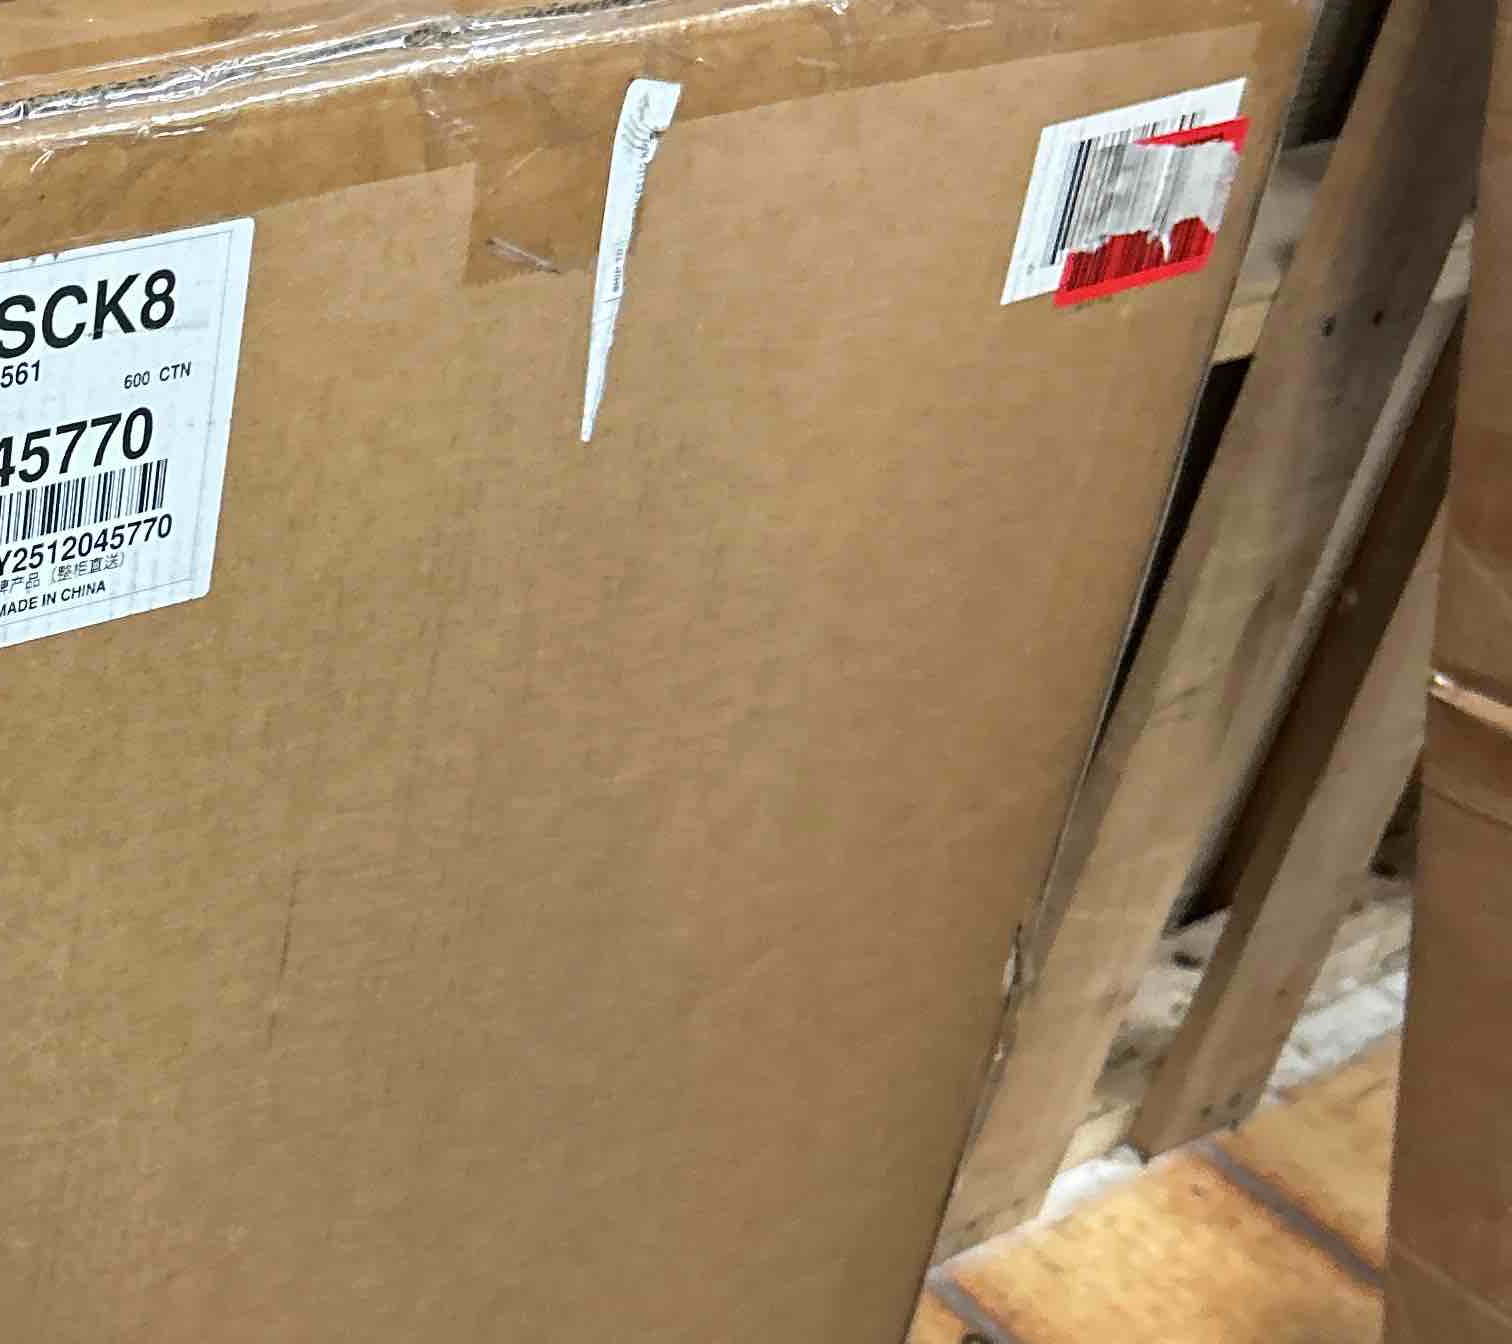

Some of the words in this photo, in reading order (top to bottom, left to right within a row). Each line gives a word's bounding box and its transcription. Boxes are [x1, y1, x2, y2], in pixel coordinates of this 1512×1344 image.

[123, 371, 151, 389] 600
[159, 361, 192, 382] CTN
[41, 591, 57, 607] IN
[60, 580, 106, 602] CHINA
